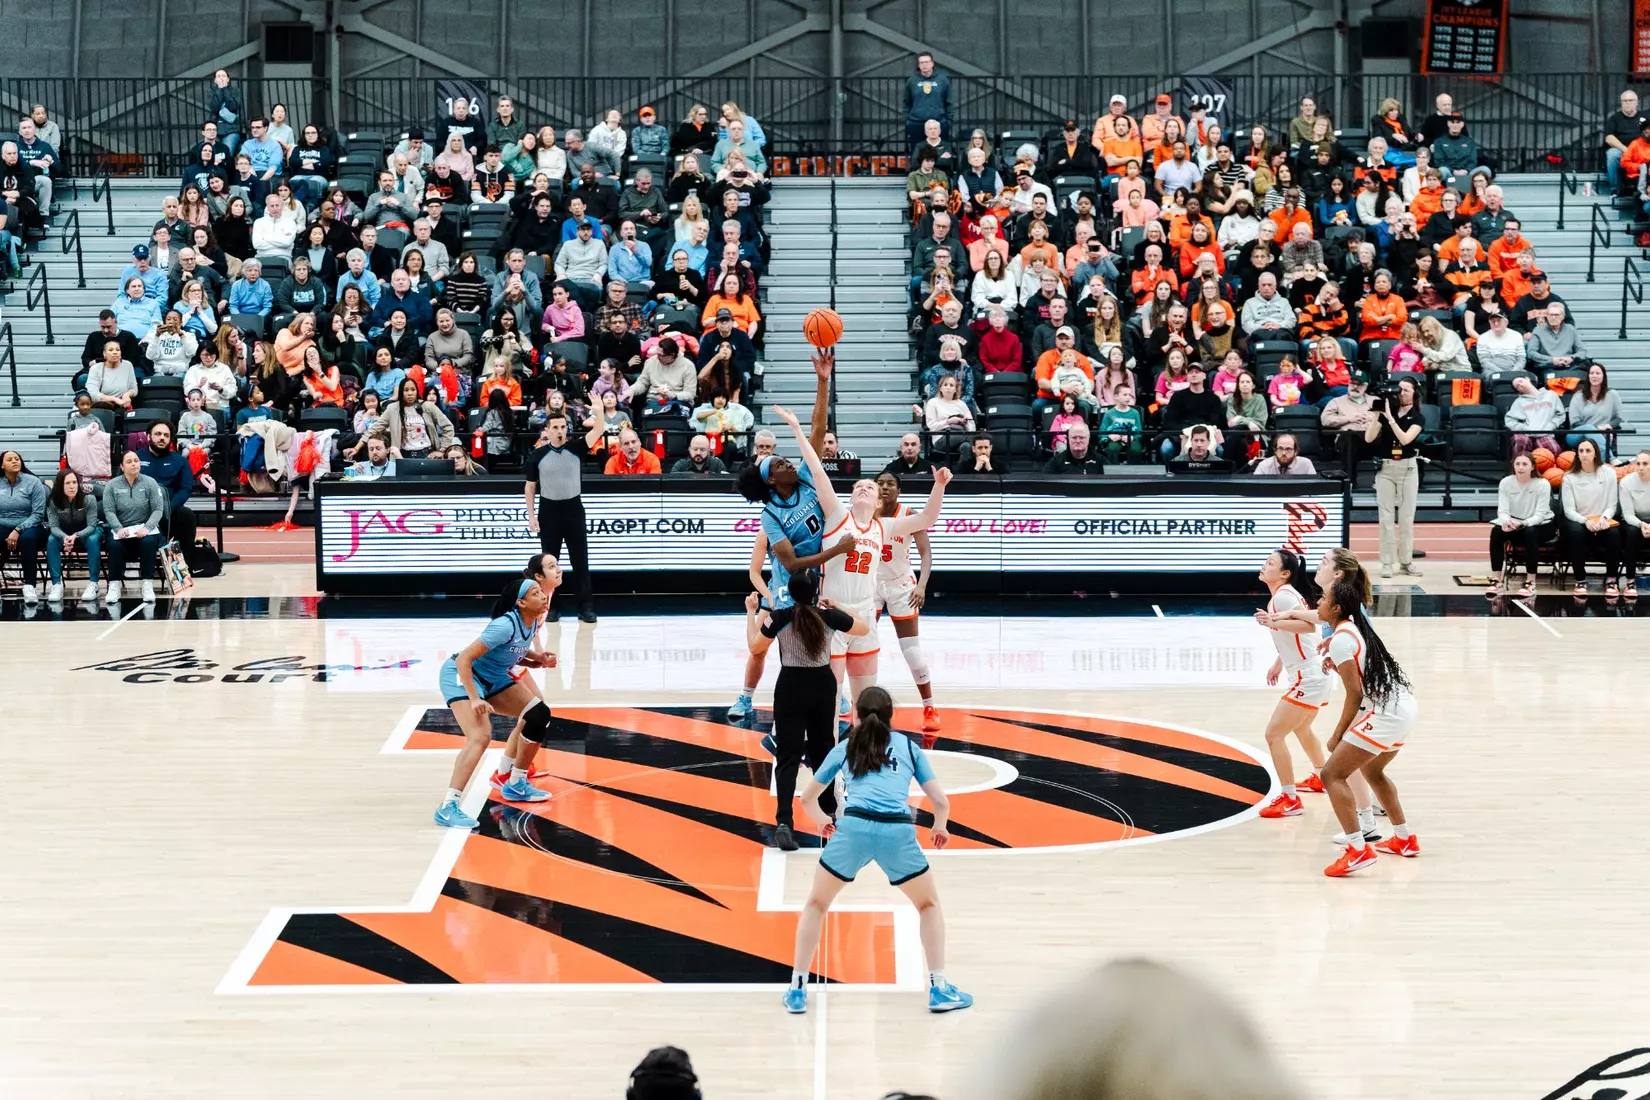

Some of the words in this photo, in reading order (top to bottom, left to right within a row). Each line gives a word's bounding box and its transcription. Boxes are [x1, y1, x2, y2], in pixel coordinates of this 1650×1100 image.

[1458, 7, 1492, 15] LEAGUE
[1432, 14, 1499, 26] CHAMPIONS
[445, 97, 480, 116] 16
[1191, 94, 1226, 112] 107
[164, 348, 176, 356] DAY
[822, 462, 840, 472] POSS.
[454, 508, 532, 522] PHYSIC
[784, 496, 819, 528] COLUMBI
[456, 526, 538, 540] THERA
[586, 518, 704, 534] JAGPT.COM
[734, 519, 761, 532] GE
[945, 519, 982, 533] YOU
[990, 519, 1047, 534] LOVE!
[1074, 519, 1162, 535] OFFICIAL
[1167, 519, 1256, 535] PARTNER
[332, 509, 451, 562] JAG
[880, 544, 893, 562] 5
[844, 550, 872, 574] 22
[122, 672, 340, 684] Court
[1294, 690, 1304, 699] P
[1361, 722, 1374, 732] P
